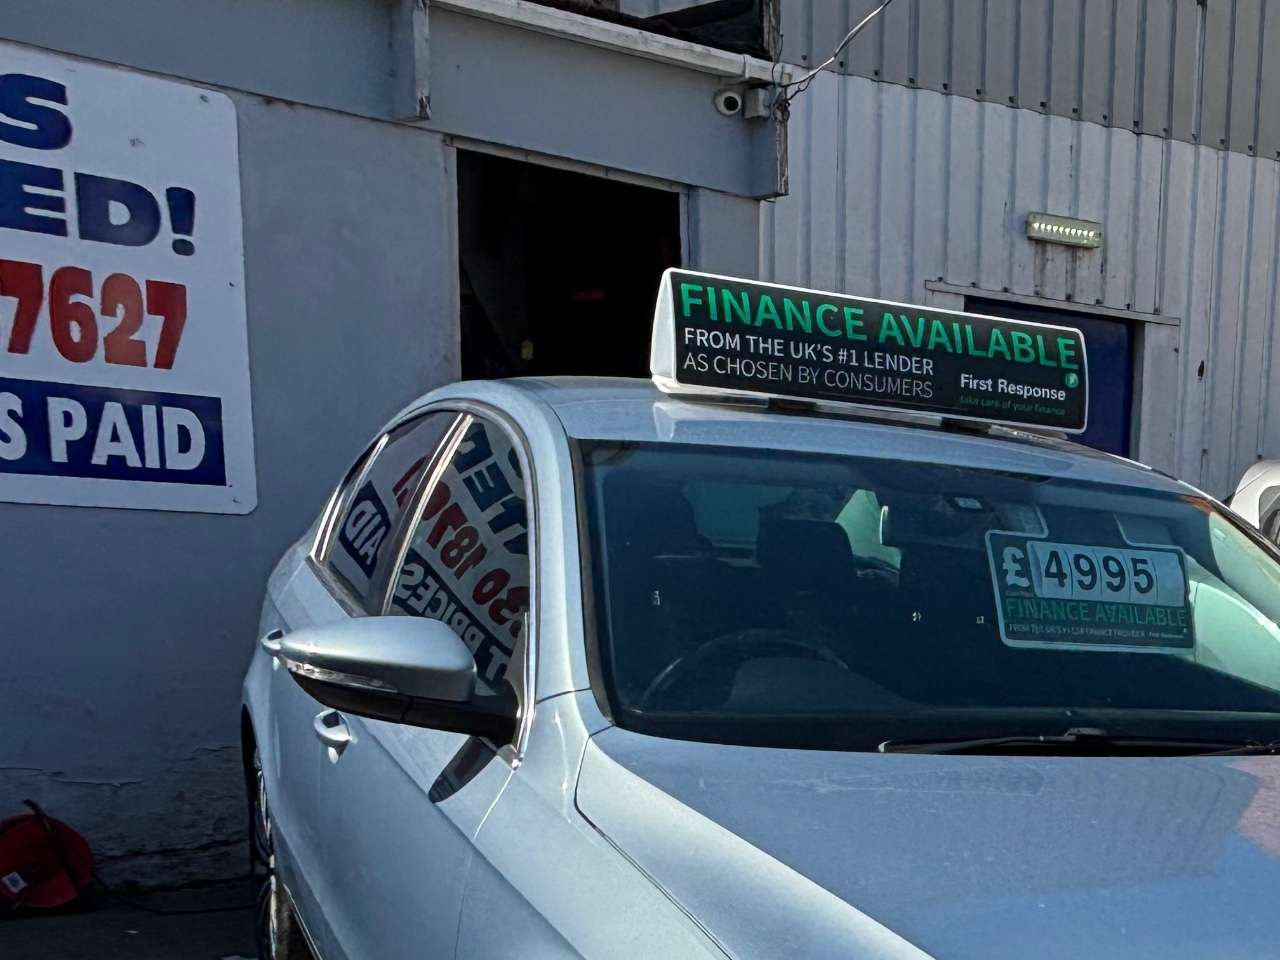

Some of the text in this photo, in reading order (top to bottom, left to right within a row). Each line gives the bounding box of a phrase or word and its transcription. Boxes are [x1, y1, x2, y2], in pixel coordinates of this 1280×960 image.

[0, 260, 188, 370] 7627
[680, 283, 1079, 370] FINANCE AVAILABLE
[683, 351, 933, 398] AS CHOSEN BY CONSUMERS
[684, 327, 933, 376] FROM THE UK'S #1 LENDER
[960, 373, 1067, 401] First Response
[46, 396, 206, 471] PAID
[1005, 599, 1187, 627] FINANCE AVAILABLE
